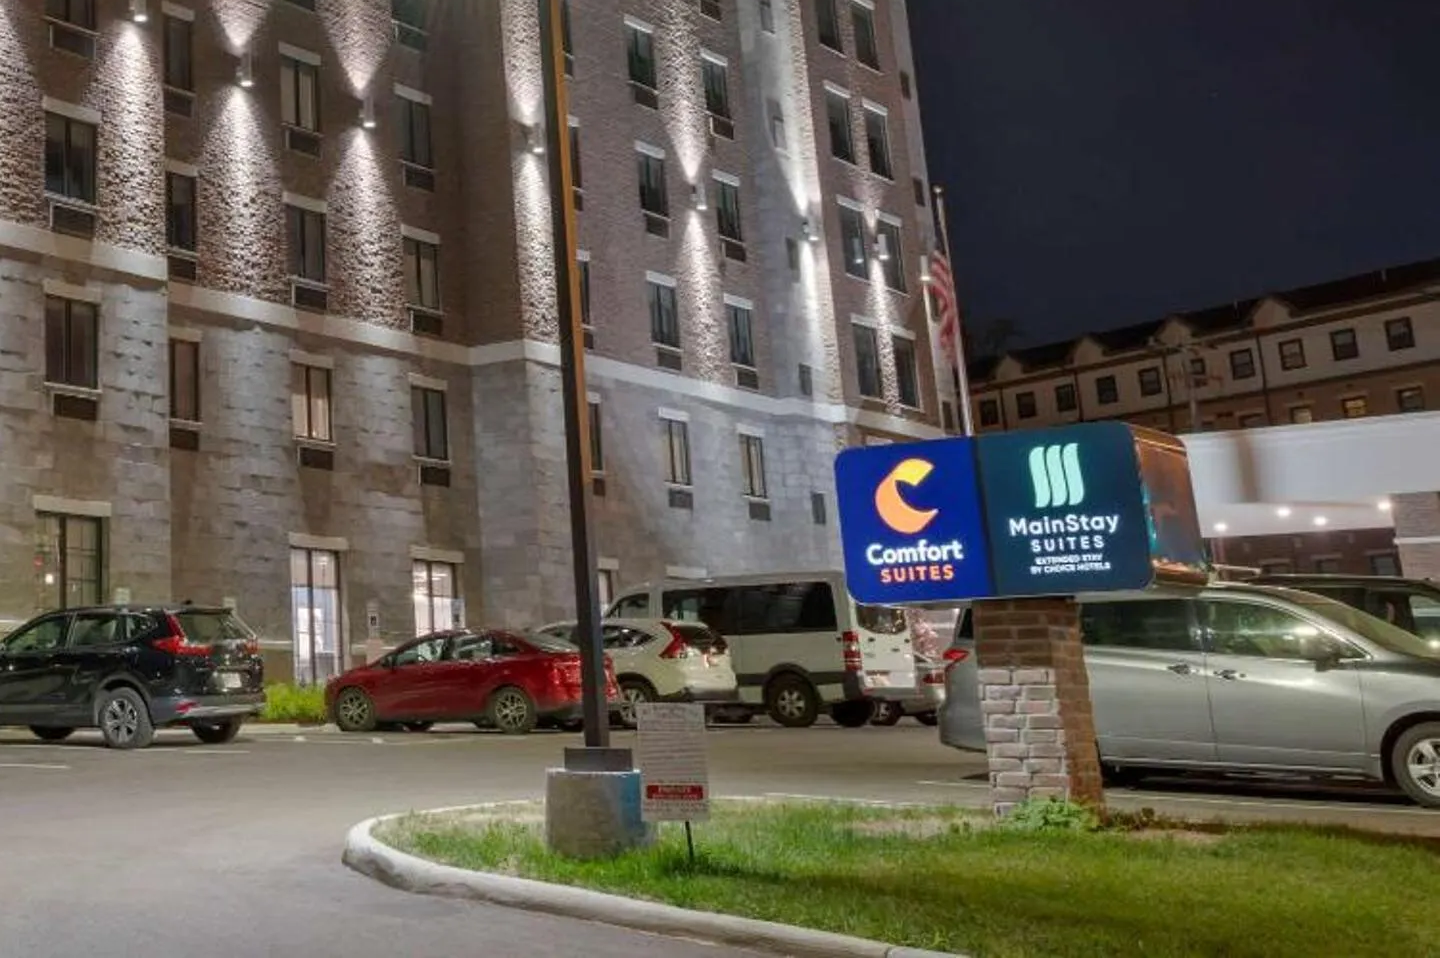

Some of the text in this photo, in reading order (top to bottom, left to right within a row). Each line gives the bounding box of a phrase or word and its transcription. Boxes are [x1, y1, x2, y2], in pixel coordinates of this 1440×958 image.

[1009, 514, 1119, 537] MainStay
[866, 539, 964, 565] Comfort
[1031, 535, 1104, 552] SUITES
[880, 564, 954, 583] SUITES
